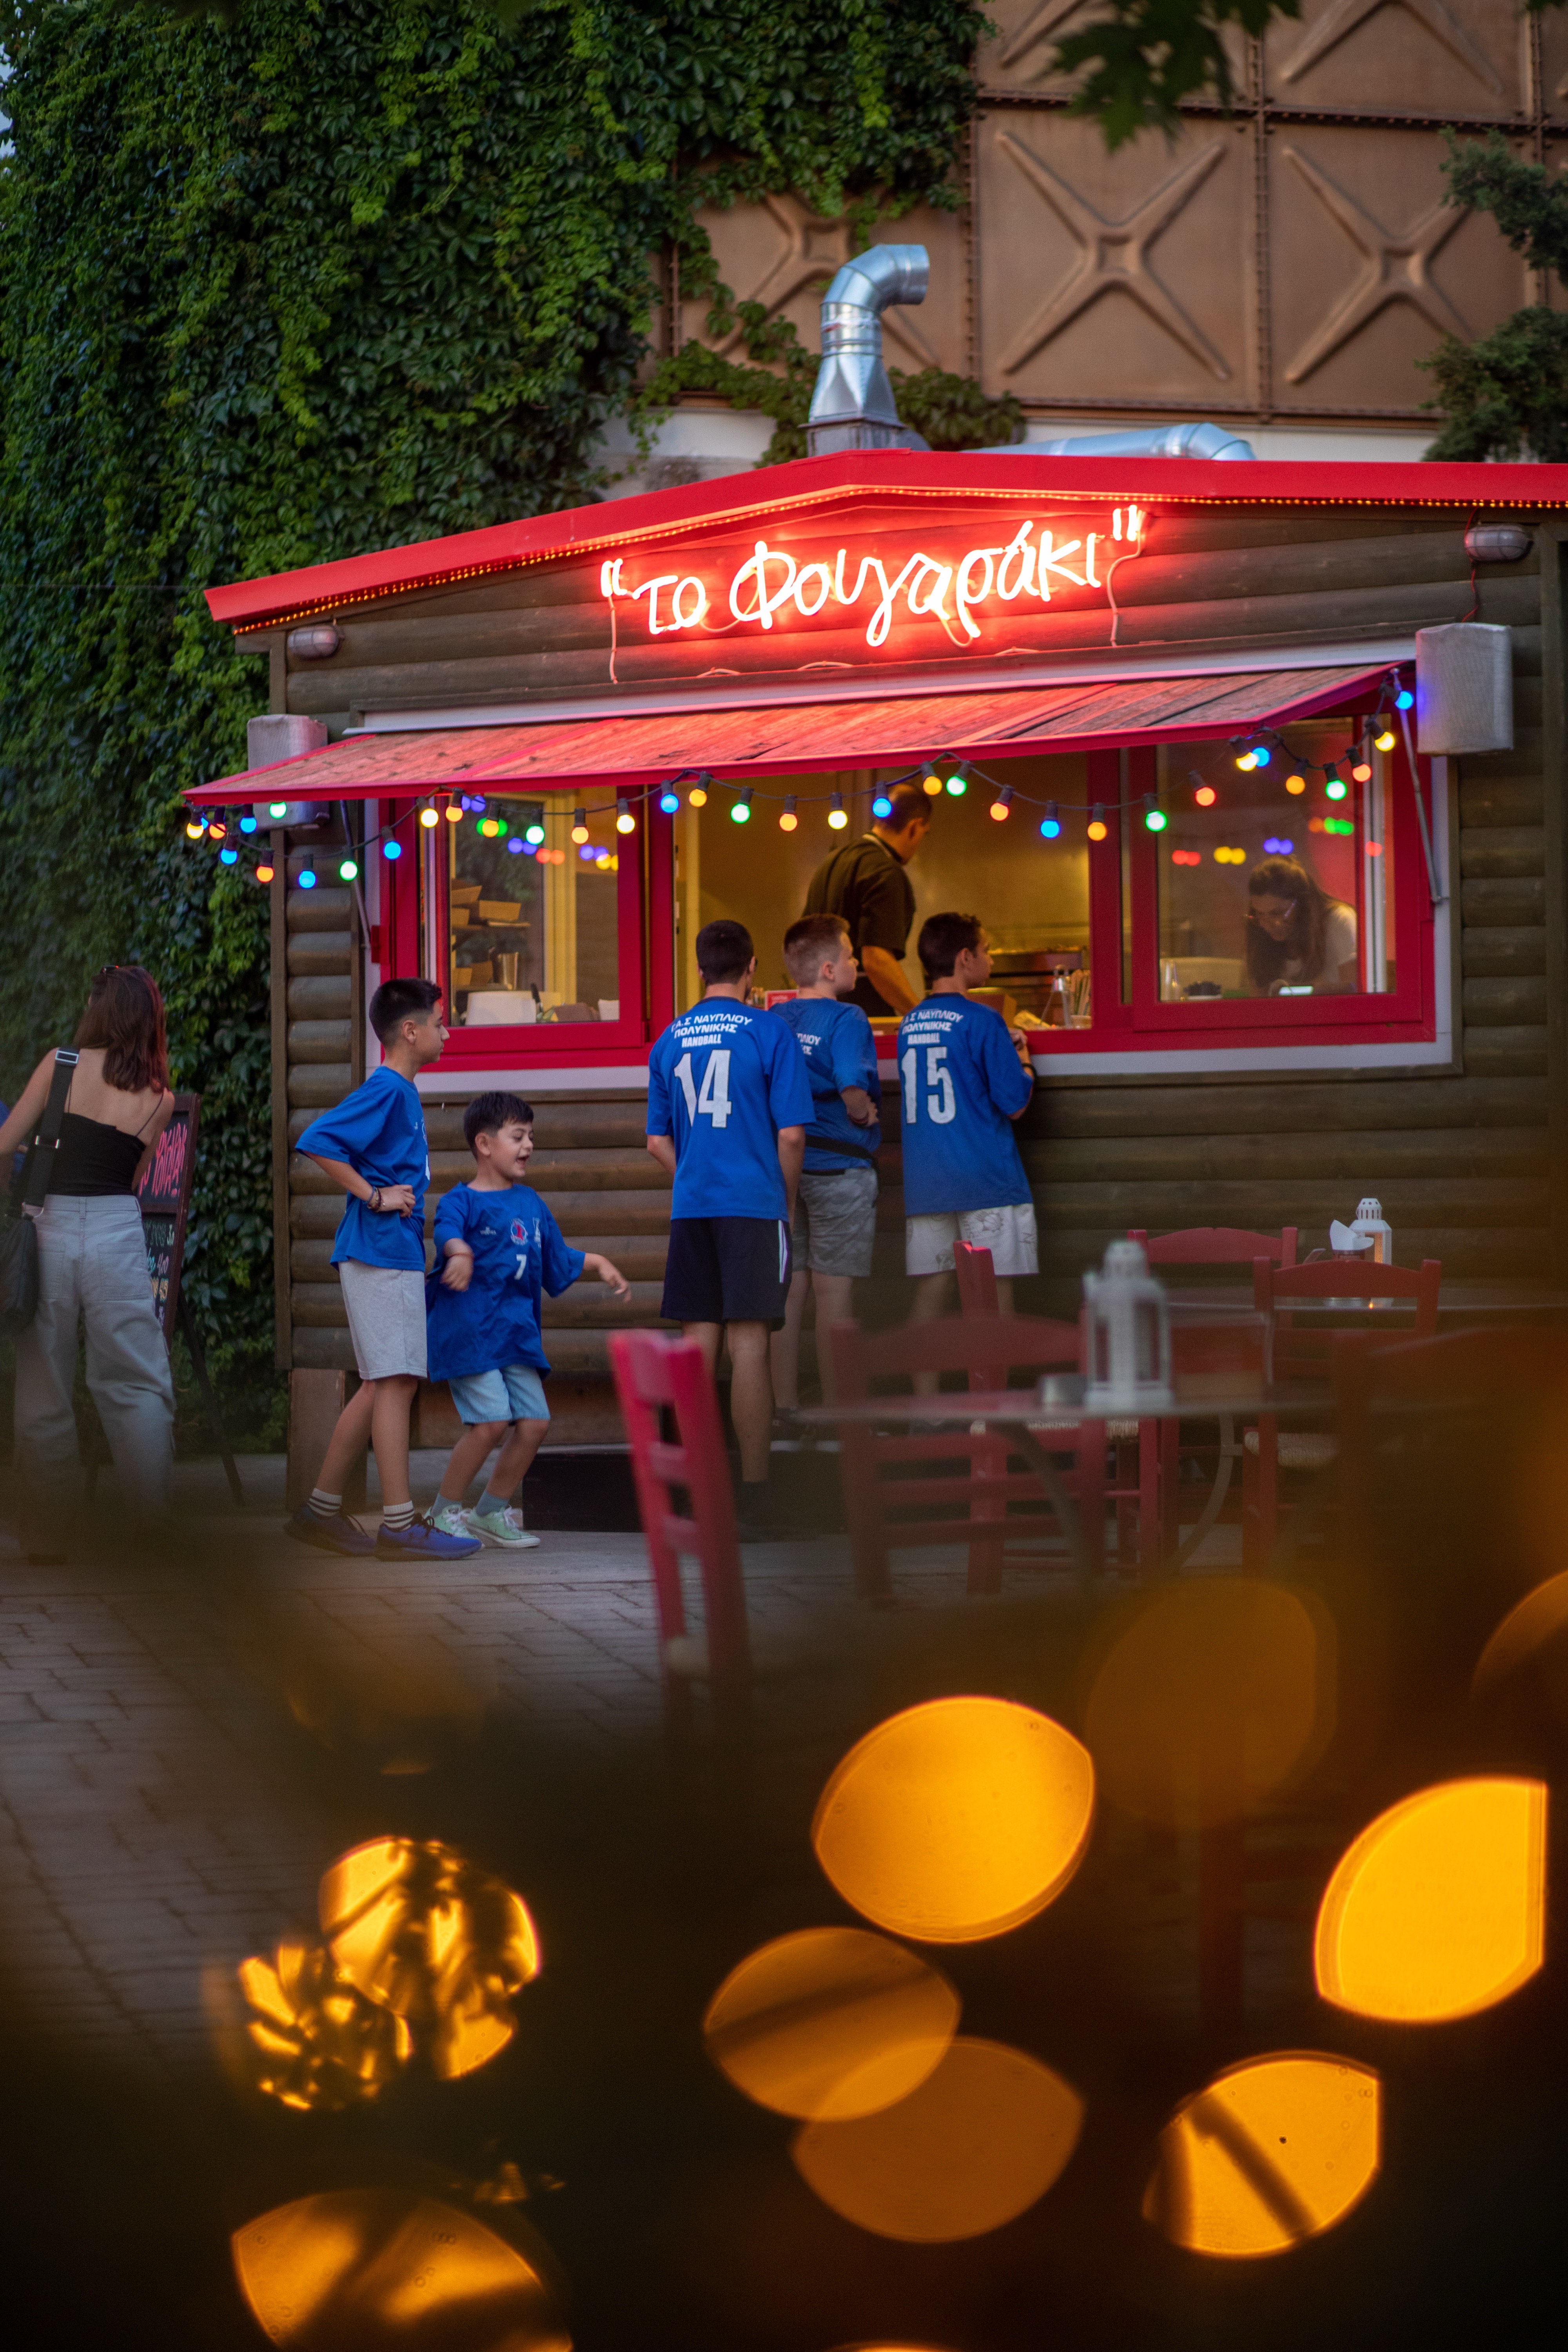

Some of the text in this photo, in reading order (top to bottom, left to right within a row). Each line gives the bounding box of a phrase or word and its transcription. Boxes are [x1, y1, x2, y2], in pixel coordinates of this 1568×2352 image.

[693, 1013, 753, 1025] ΝΑΥΠΛΙΟΥ
[917, 1010, 964, 1023] ΝΑΥΠΛΙΟΥ
[674, 1023, 738, 1039] ΠΟΛΥΝΙΚΗΣ
[902, 1021, 952, 1035] ΠΟΛΥΝΙΚΗΣ
[682, 1034, 721, 1048] HANDBALL
[907, 1033, 940, 1044] HANDBALL
[673, 1049, 732, 1128] 14
[901, 1046, 956, 1124] 15
[514, 1254, 527, 1280] 7
